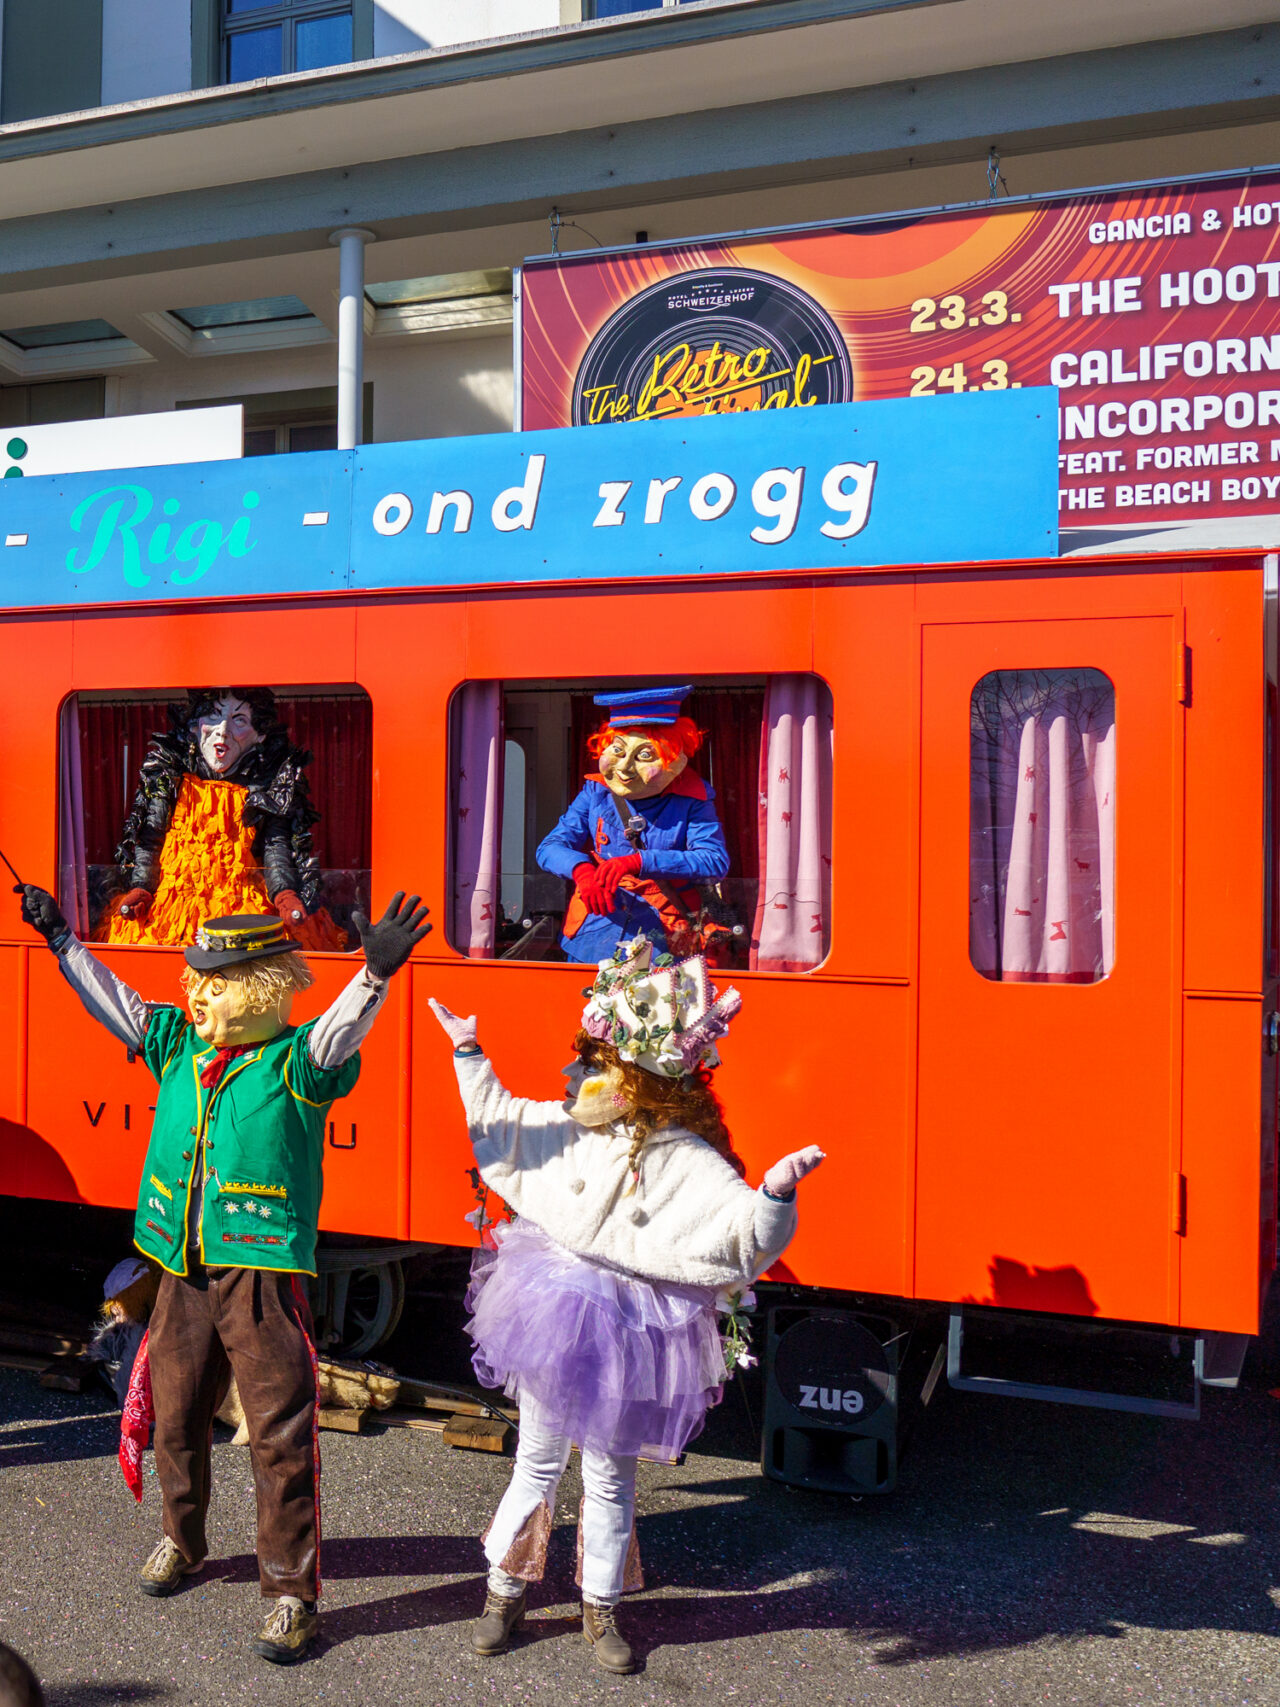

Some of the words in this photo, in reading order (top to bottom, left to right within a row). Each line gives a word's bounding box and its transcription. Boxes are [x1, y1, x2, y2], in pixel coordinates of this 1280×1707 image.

[1089, 213, 1191, 244] GANCIA
[1201, 209, 1222, 231] &
[668, 292, 755, 309] SCHWEIZERHOF
[1048, 276, 1142, 318] THE
[1160, 262, 1280, 308] HOOT
[910, 290, 1022, 333] 23.3.
[910, 359, 1022, 397] 24.3.
[1050, 335, 1280, 388] CALIFORN
[583, 384, 631, 424] The
[637, 342, 771, 415] Retro
[1136, 441, 1260, 471] FORMER
[1115, 480, 1210, 507] BEACH
[1222, 476, 1280, 501] BOY
[65, 484, 260, 588] Rigi
[372, 453, 547, 536] ond
[592, 461, 878, 546] zrogg
